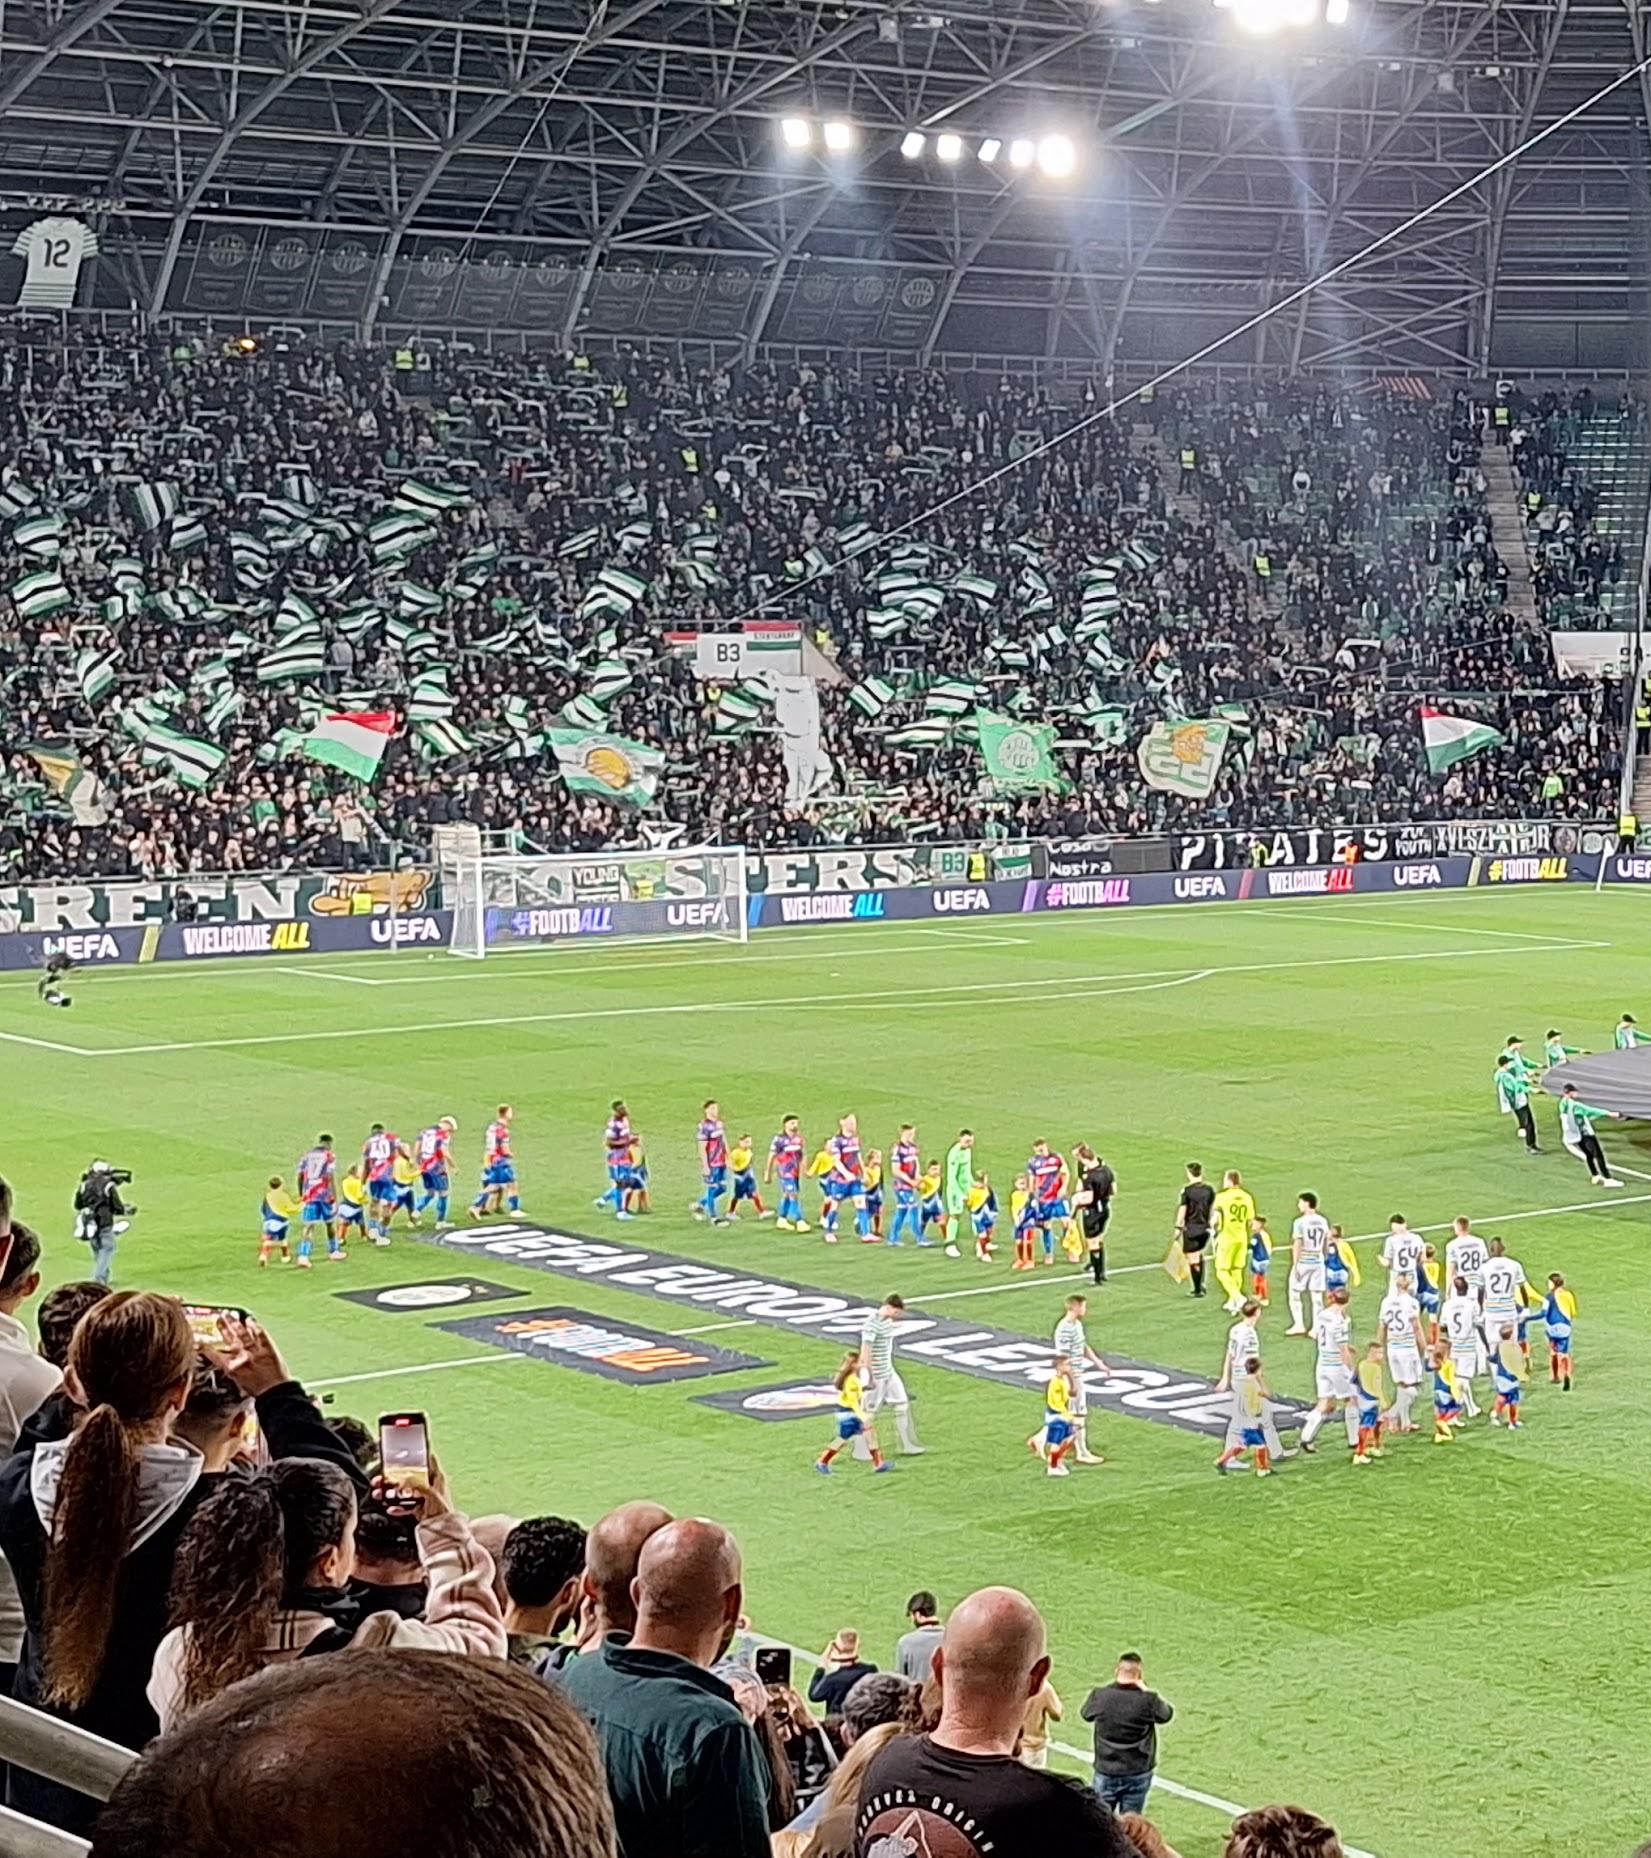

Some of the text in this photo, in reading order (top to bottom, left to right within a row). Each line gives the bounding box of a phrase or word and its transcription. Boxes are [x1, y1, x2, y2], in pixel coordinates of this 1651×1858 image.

[44, 237, 70, 268] 12
[717, 642, 741, 662] B3
[1181, 828, 1388, 870] PIATES
[942, 852, 966, 874] B3
[1050, 859, 1113, 877] Nostra
[1394, 864, 1442, 886] UEFA
[1489, 857, 1568, 881] #FOOTBALL
[1046, 879, 1130, 906] #FOOTBALL
[1174, 876, 1227, 898] UEFA
[1268, 868, 1354, 894] WELCOME ALL
[781, 893, 885, 922] WELCOME ALL
[933, 888, 990, 912] UEFA
[512, 907, 613, 936] #FOOTBALL
[667, 903, 730, 926] UEFA
[182, 921, 310, 955] WELCOME ALL
[370, 917, 442, 943] UEFA
[43, 934, 120, 960] UEFA
[444, 1224, 649, 1274] UEFA
[1307, 1228, 1324, 1248] 47
[1398, 1245, 1418, 1269] 64
[1460, 1250, 1481, 1273] 28
[1489, 1272, 1512, 1294] 27
[1385, 1309, 1405, 1332] 25
[1453, 1312, 1462, 1334] 5
